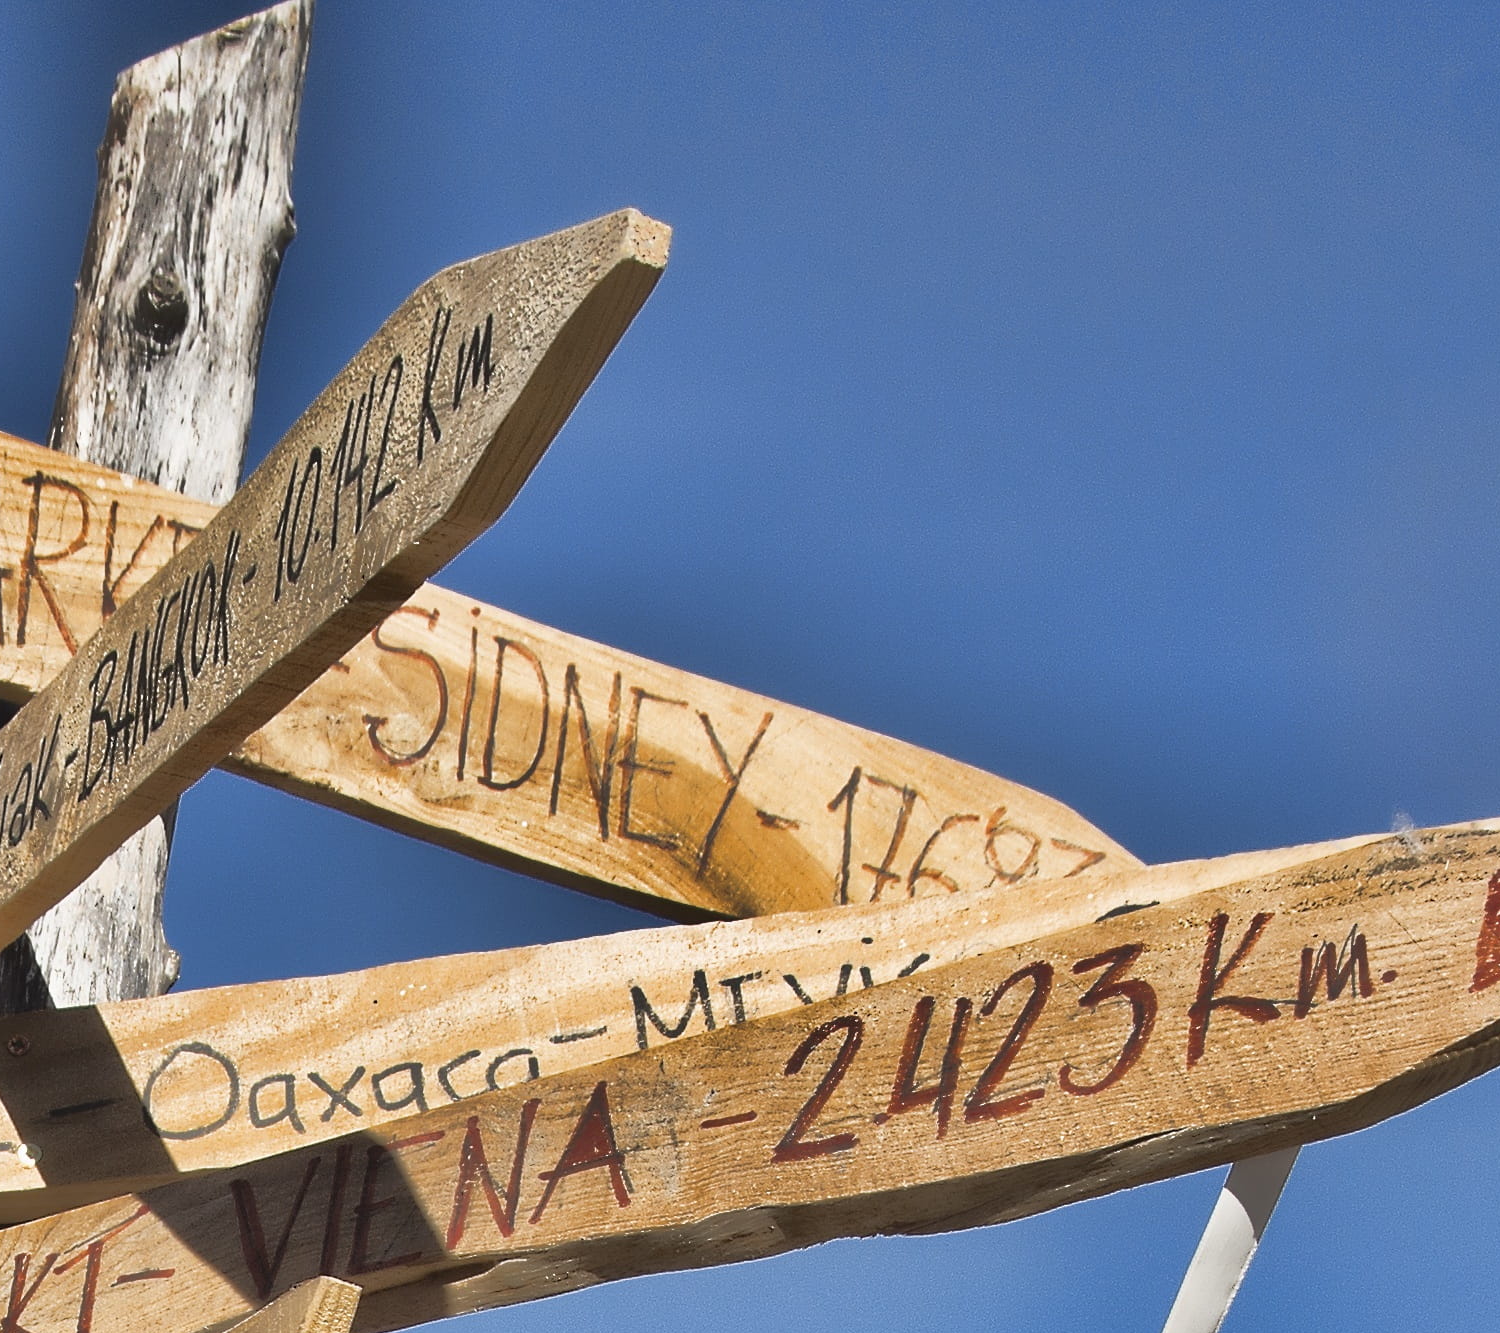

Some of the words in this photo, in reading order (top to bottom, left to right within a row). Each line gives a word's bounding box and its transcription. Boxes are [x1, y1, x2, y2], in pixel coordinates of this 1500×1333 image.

[77, 529, 241, 803] BANGKOK
[272, 354, 404, 603] 10.142
[361, 608, 774, 880] SIDNEY
[142, 1042, 540, 1141] Oaxaca
[230, 1080, 634, 1300] VIENA
[771, 943, 1156, 1165] 2.423
